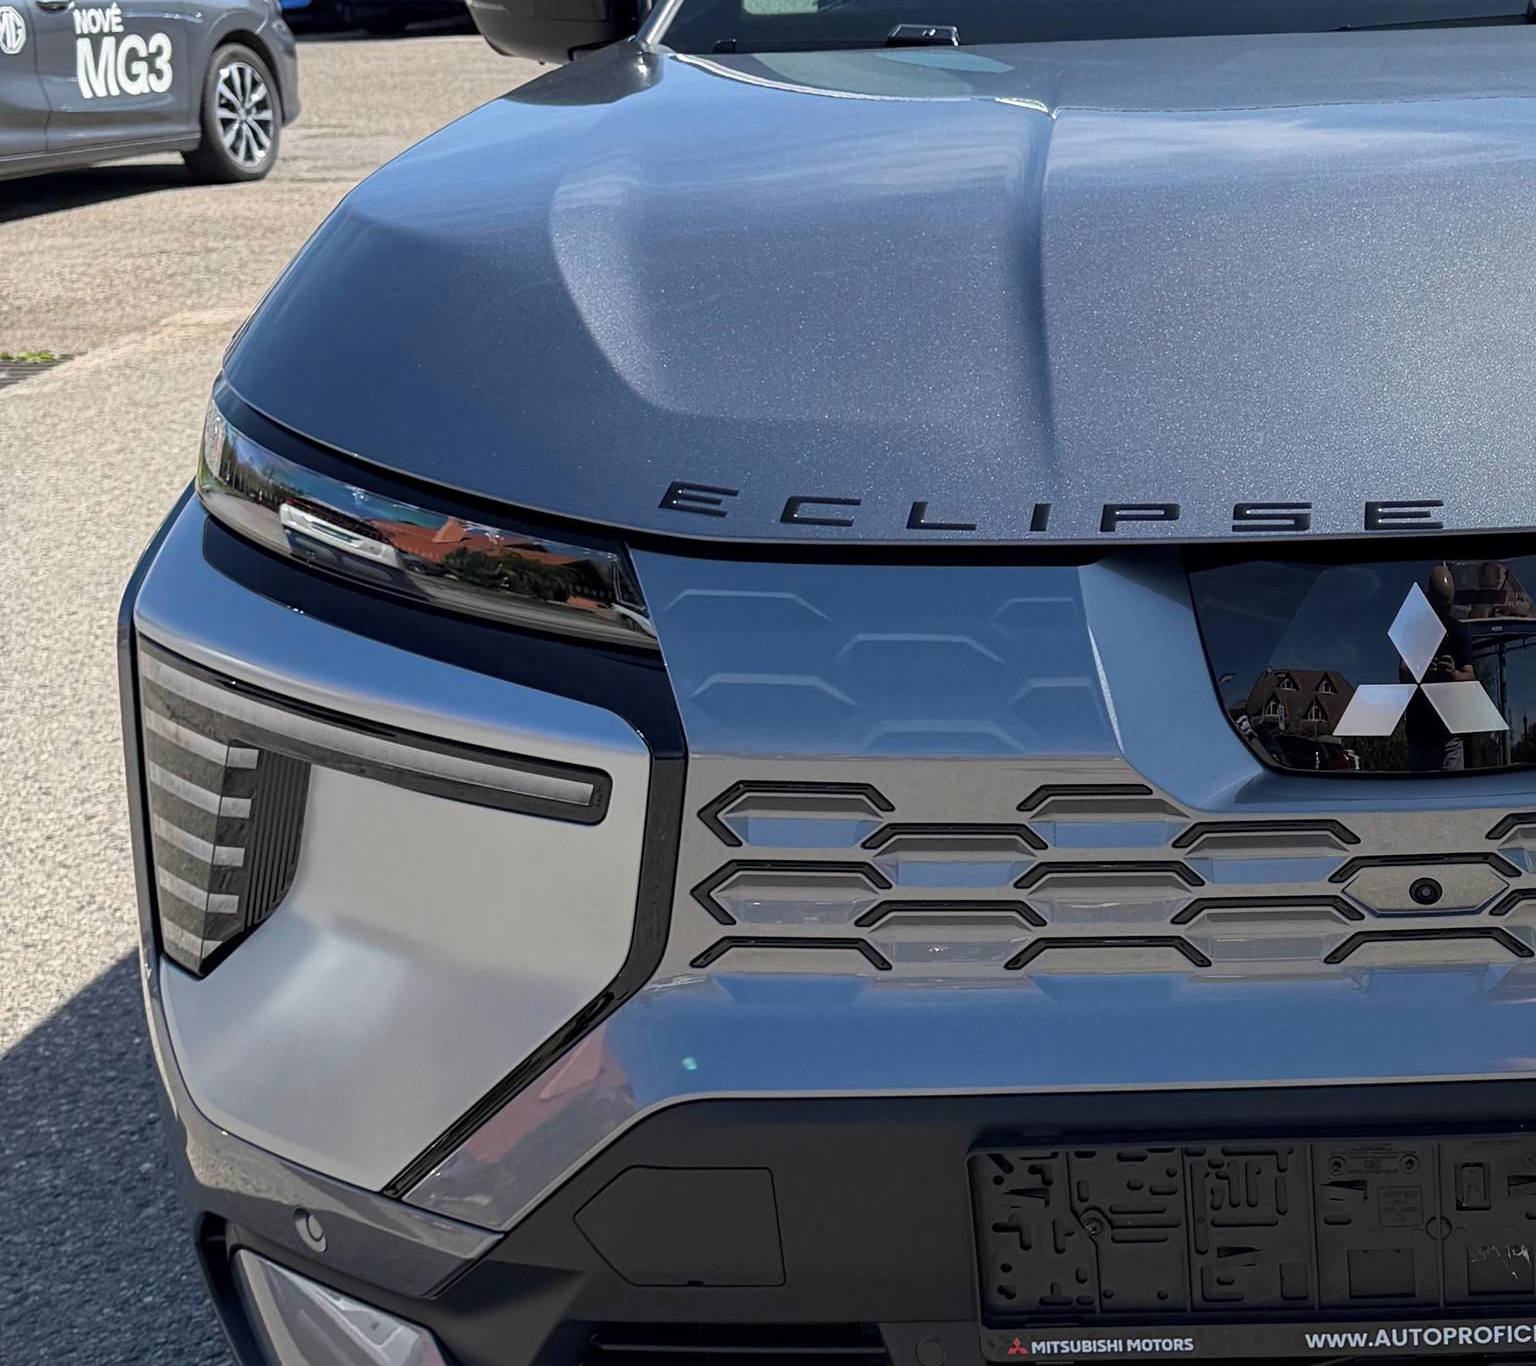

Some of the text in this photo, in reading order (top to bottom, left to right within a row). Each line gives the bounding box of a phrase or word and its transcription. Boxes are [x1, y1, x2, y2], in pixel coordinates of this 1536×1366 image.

[72, 2, 125, 35] NOVÉ
[76, 32, 173, 99] MG3
[658, 480, 1444, 533] ECLIPSE
[1031, 1338, 1194, 1355] MITSUBISHI MOTORS
